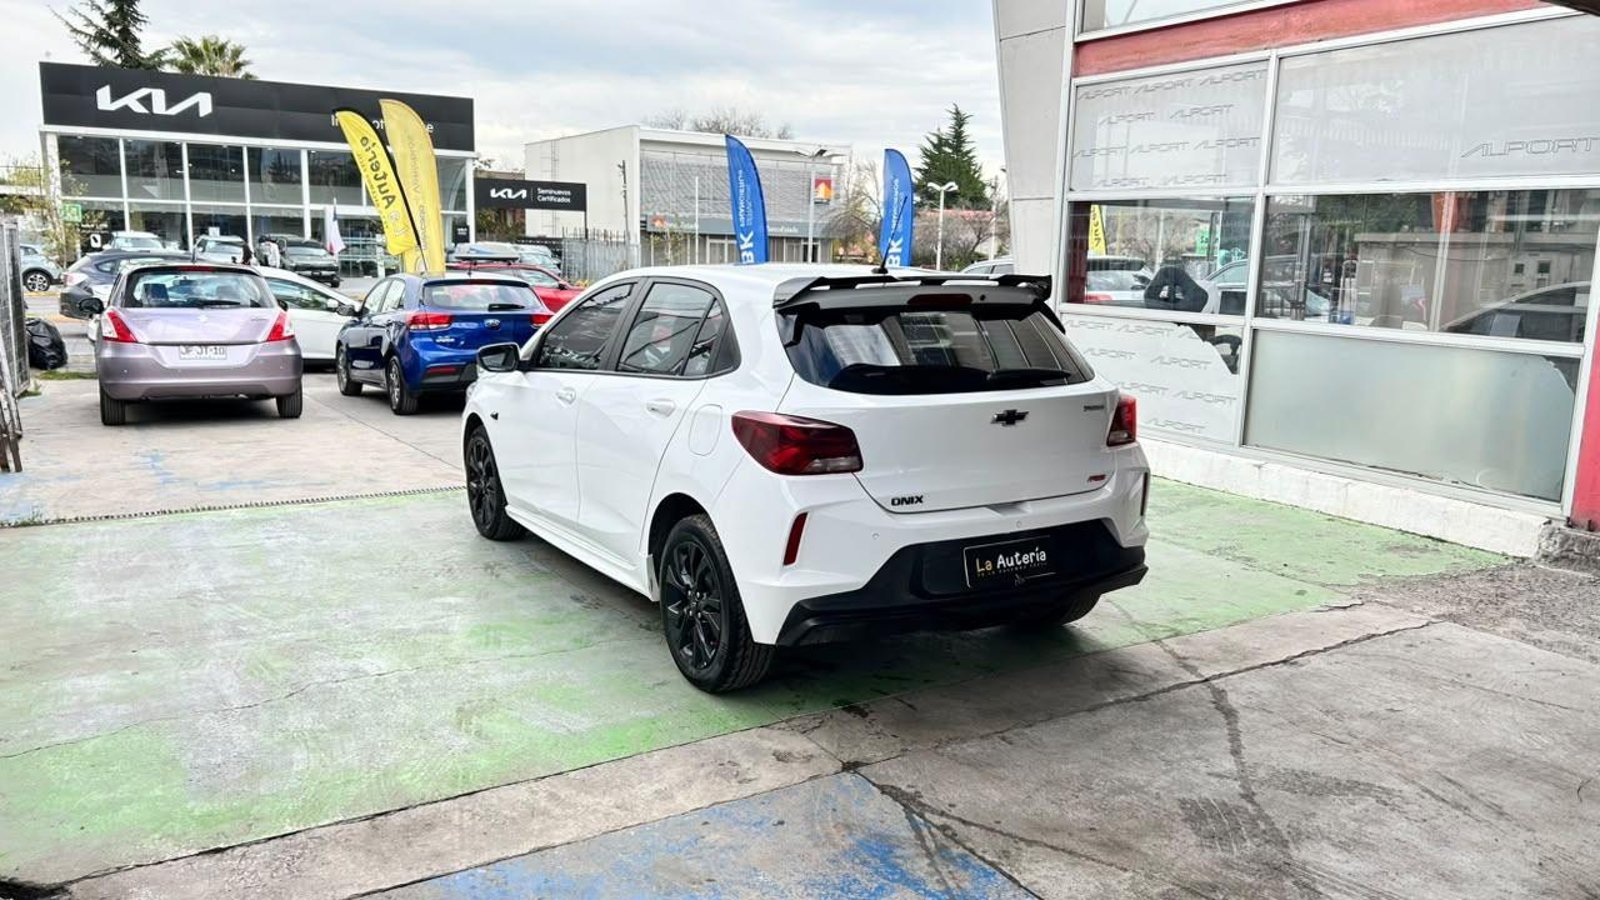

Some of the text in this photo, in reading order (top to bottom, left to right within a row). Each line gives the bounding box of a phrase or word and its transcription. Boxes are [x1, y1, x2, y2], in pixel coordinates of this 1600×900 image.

[1135, 79, 1193, 95] ALPORT
[1200, 70, 1267, 86] ALPORT
[1099, 104, 1234, 125] ALPORT ALPORT
[1130, 143, 1189, 154] ALPORT
[1193, 136, 1260, 150] ALPORT
[1461, 136, 1600, 158] ALPORT
[537, 187, 572, 196] Seminuevos
[537, 195, 571, 203] Certificados
[1117, 324, 1174, 337] ALPORT
[1151, 355, 1212, 370] ALPORT
[1173, 390, 1237, 405] ALPORT
[891, 495, 924, 506] ONIX
[976, 546, 1047, 572] La Autería
